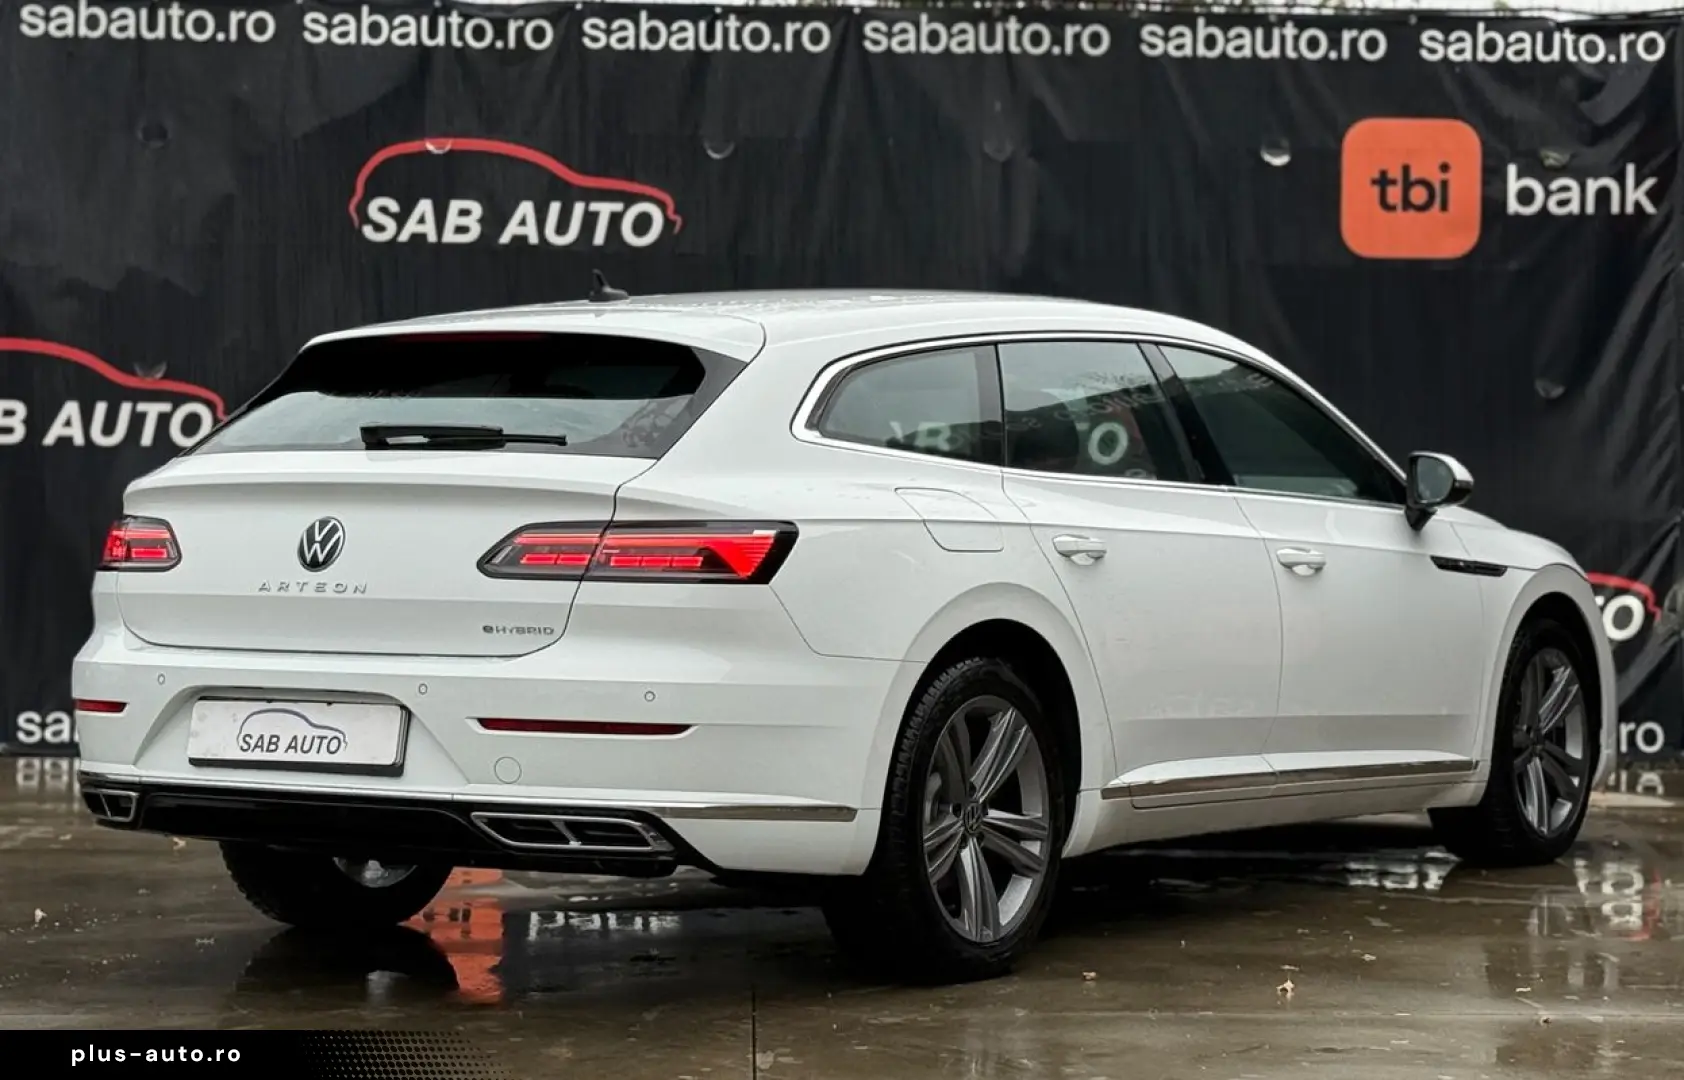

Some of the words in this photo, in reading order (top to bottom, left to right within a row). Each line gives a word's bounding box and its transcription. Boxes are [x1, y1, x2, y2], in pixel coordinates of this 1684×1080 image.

[19, 0, 277, 42] sabauto.ro
[302, 5, 555, 51] sabauto.ro
[582, 10, 832, 53] sabauto.ro
[862, 14, 1112, 56] sabauto.ro
[1139, 18, 1388, 61] sabauto.ro
[1418, 22, 1667, 64] sabauto.ro
[1370, 162, 1451, 213] tbi
[1505, 162, 1659, 216] bank
[361, 197, 483, 244] SAB
[499, 200, 665, 247] AUTO
[41, 399, 215, 448] AUTO
[257, 581, 369, 595] ARTEON
[1595, 594, 1646, 641] O
[16, 710, 79, 744] sa
[239, 733, 281, 753] SAB
[284, 734, 341, 755] AUTO
